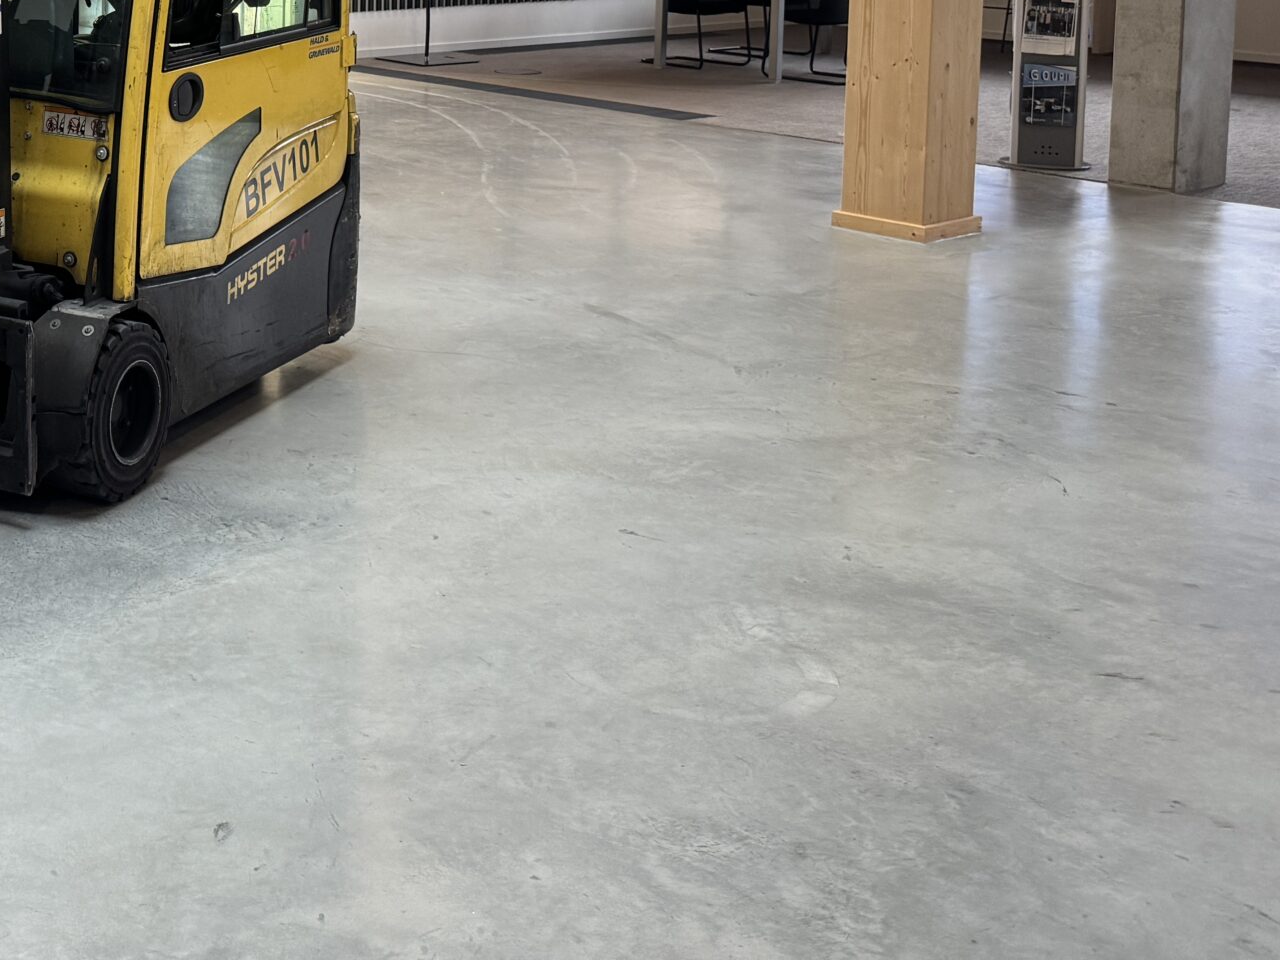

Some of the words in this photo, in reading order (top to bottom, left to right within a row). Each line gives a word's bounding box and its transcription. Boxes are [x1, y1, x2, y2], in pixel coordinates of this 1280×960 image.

[309, 45, 340, 59] GRUNEWALD
[310, 35, 324, 45] HALD
[244, 130, 319, 218] BFV101
[227, 244, 285, 305] HYSTER
